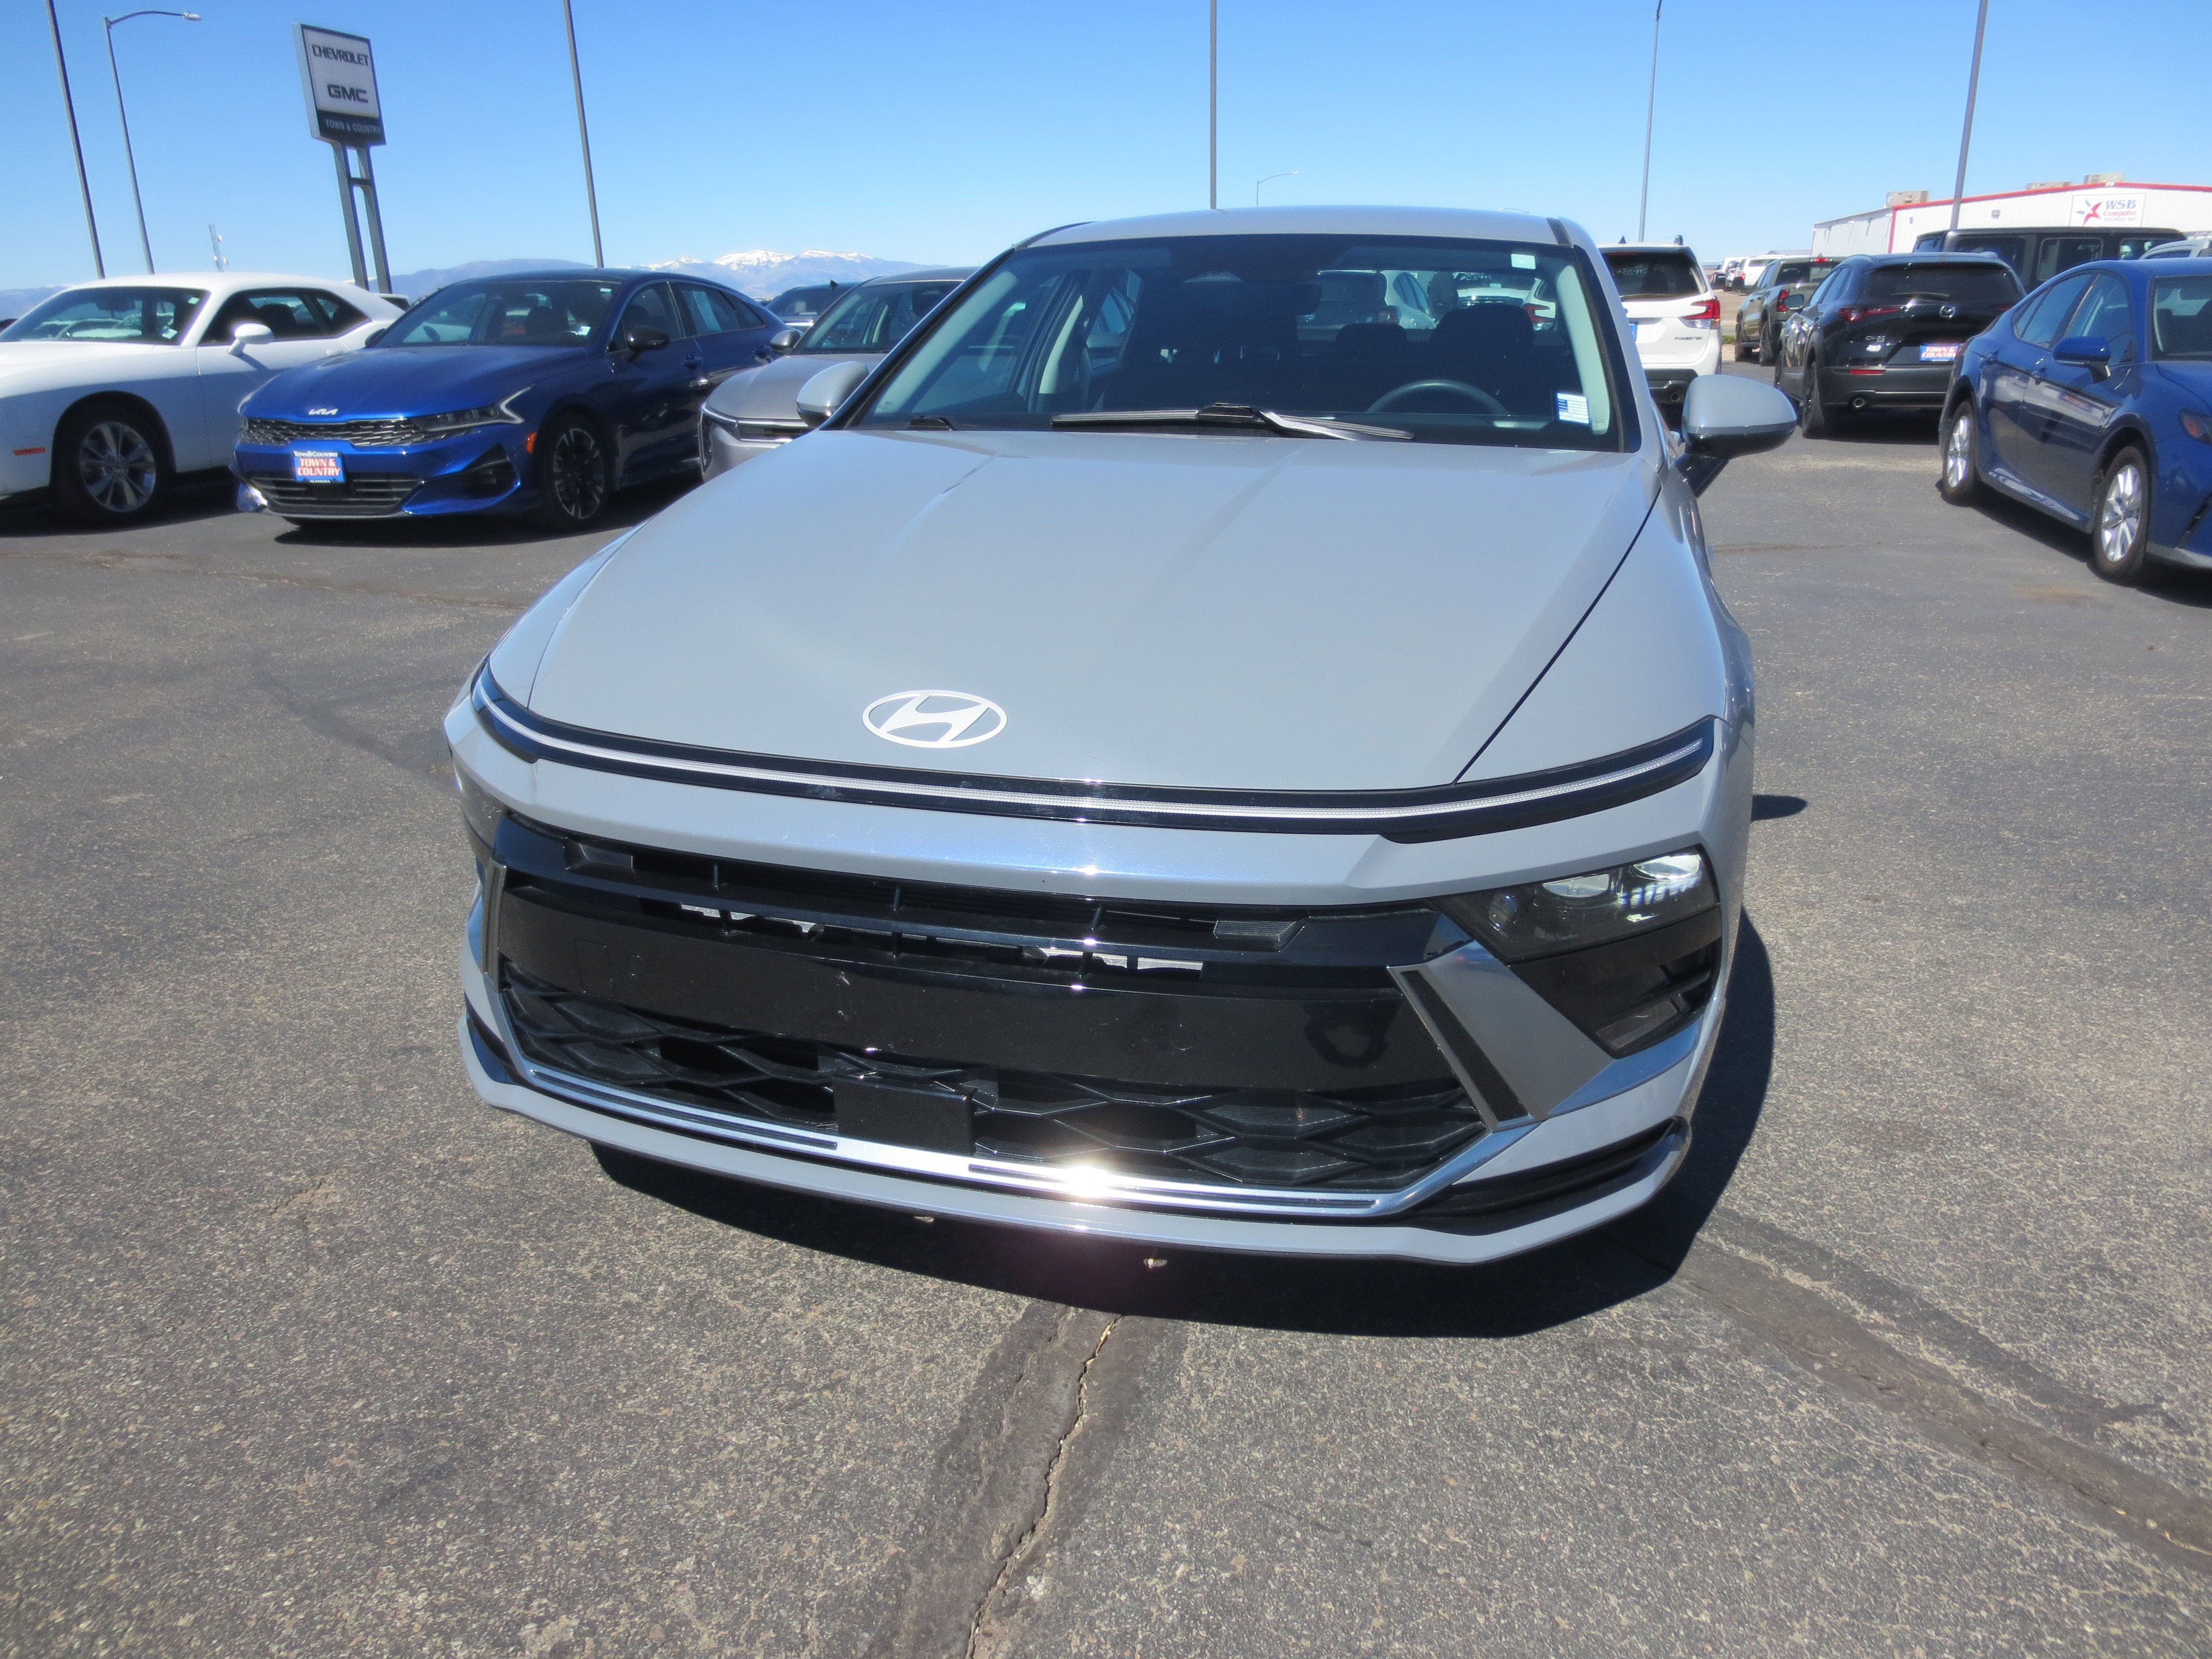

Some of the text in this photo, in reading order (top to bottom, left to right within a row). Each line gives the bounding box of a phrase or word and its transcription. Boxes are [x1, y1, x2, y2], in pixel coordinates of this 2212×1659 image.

[312, 44, 369, 66] CHEVROLET
[327, 84, 369, 103] GMC
[326, 119, 345, 130] TOWN
[352, 122, 381, 134] COUNTRY
[2105, 199, 2137, 209] WSB
[300, 457, 337, 467] TOWN &
[297, 467, 342, 476] COUNTRY
